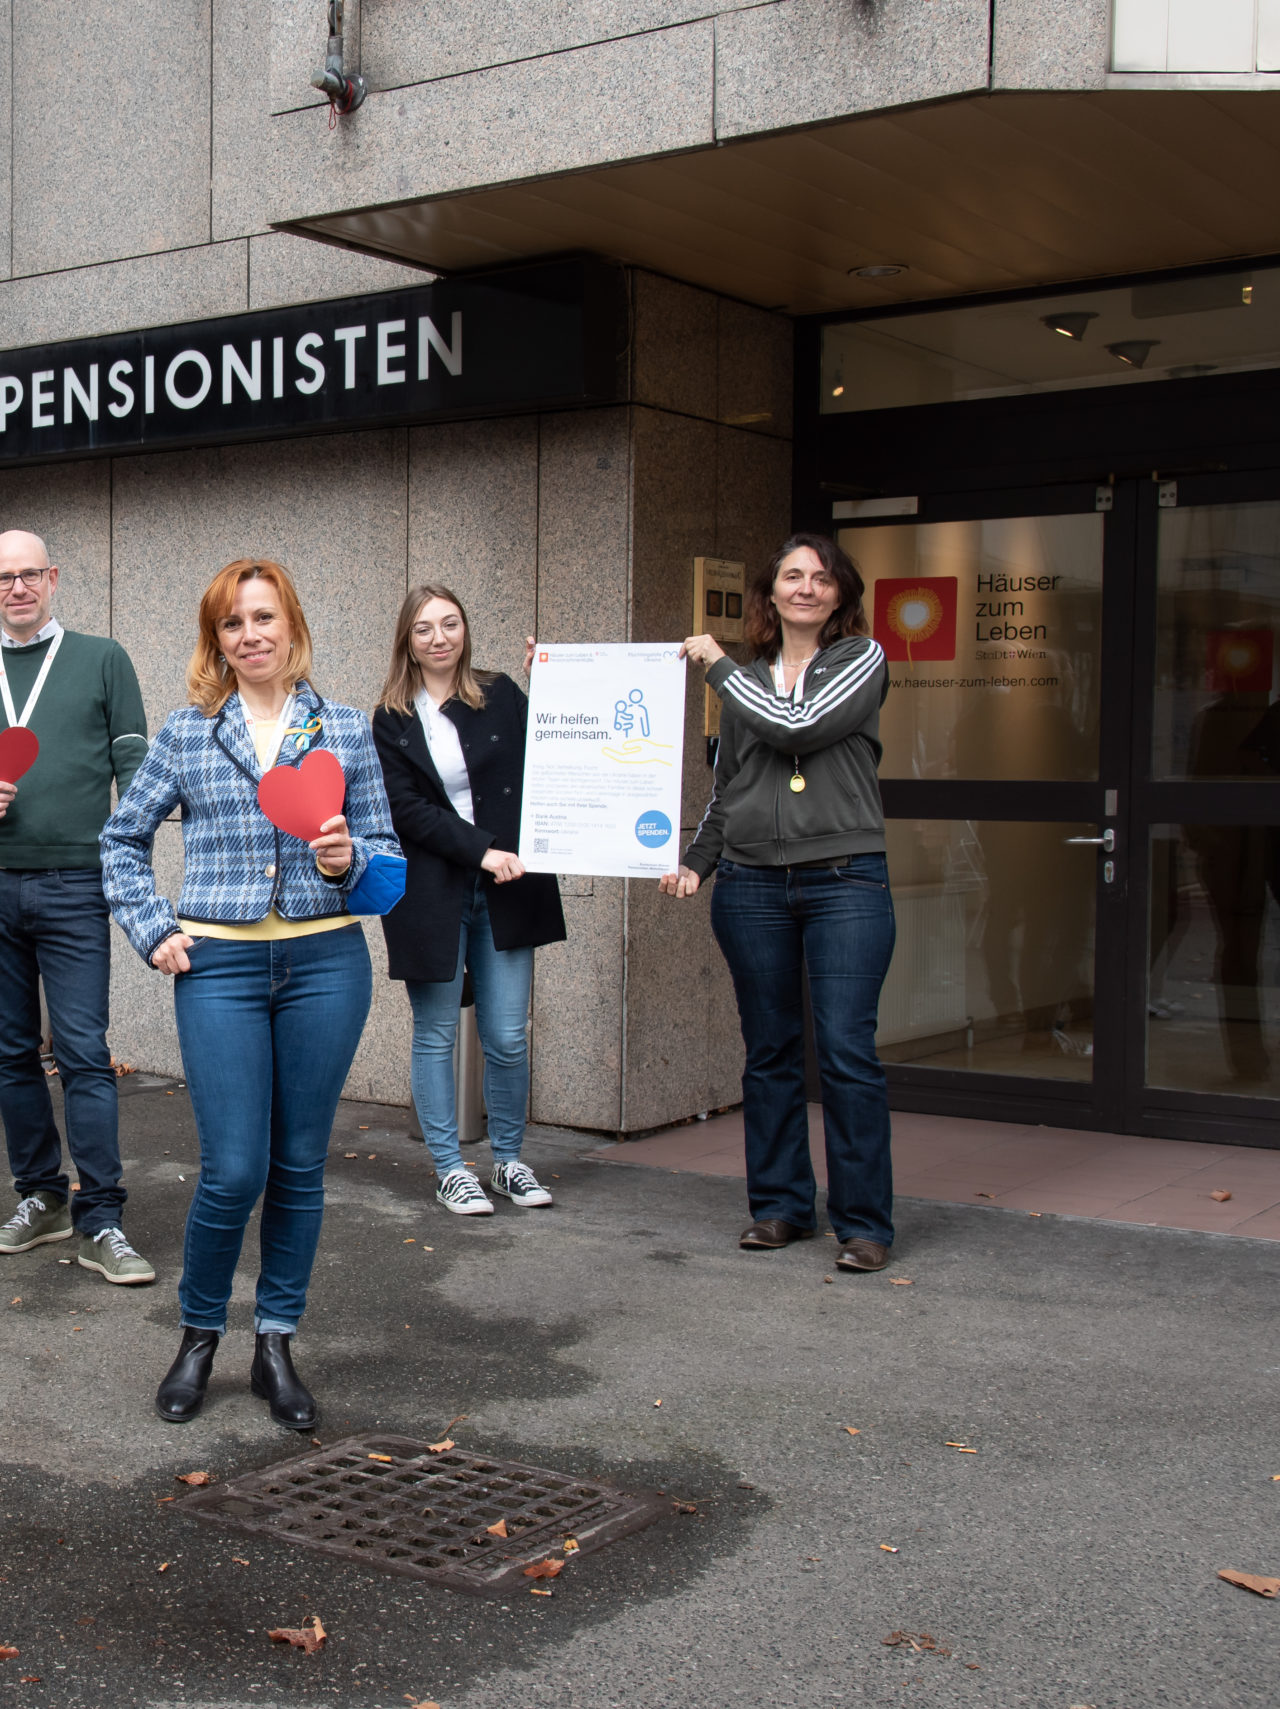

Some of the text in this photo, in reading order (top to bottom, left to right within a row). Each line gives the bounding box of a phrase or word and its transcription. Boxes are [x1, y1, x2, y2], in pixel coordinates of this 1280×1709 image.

[977, 574, 1060, 593] Häuser
[976, 602, 1023, 617] zum
[976, 622, 1047, 641] Leben
[889, 676, 1058, 689] w.haeuser-zum-leben.com
[536, 712, 599, 725] Wir helfen
[535, 728, 612, 741] gemeinsam.
